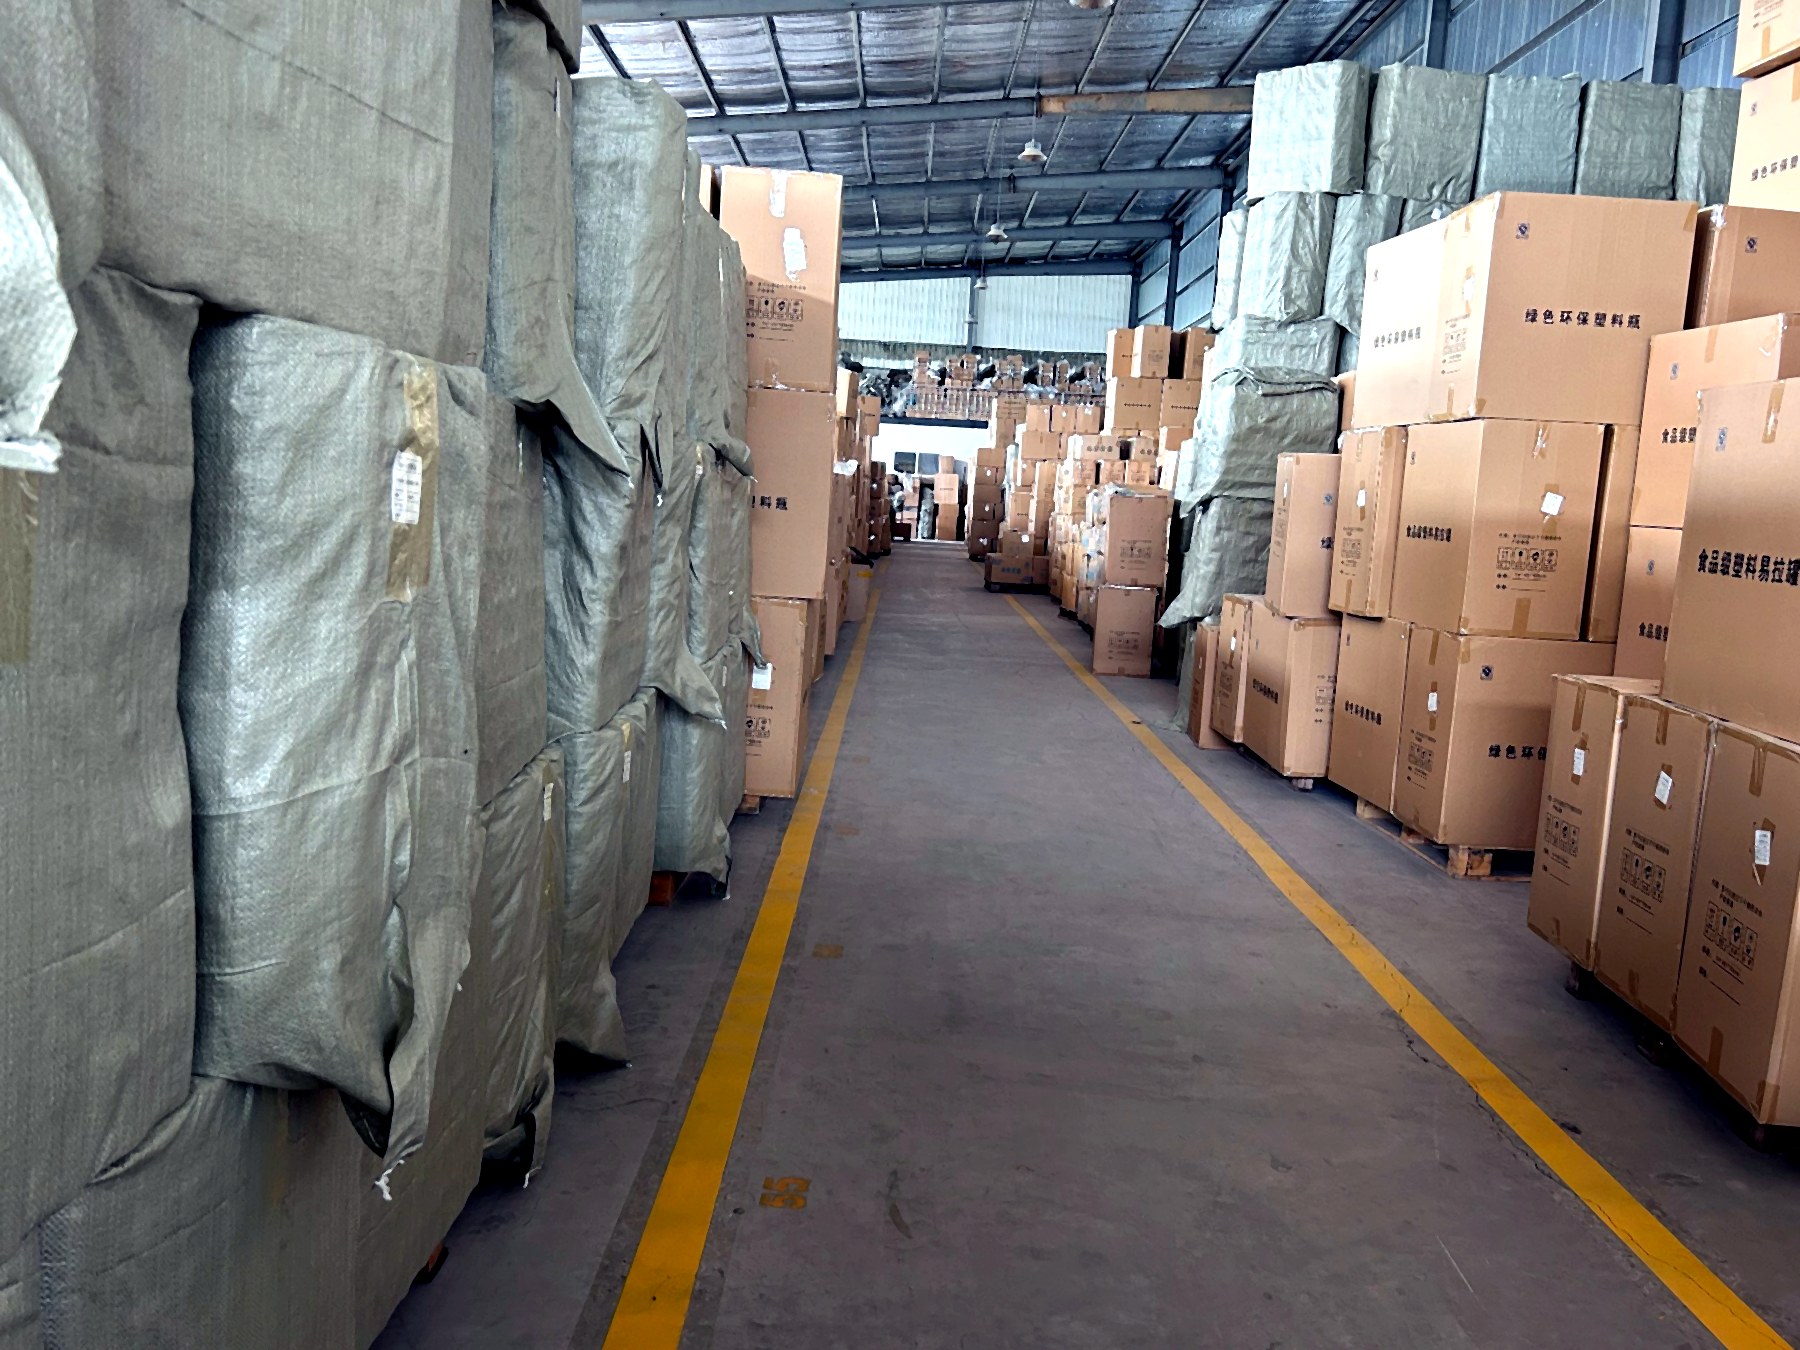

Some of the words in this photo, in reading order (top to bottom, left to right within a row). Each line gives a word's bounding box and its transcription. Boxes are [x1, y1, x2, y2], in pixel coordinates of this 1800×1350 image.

[1525, 308, 1641, 330] 绿色环保塑料瓶
